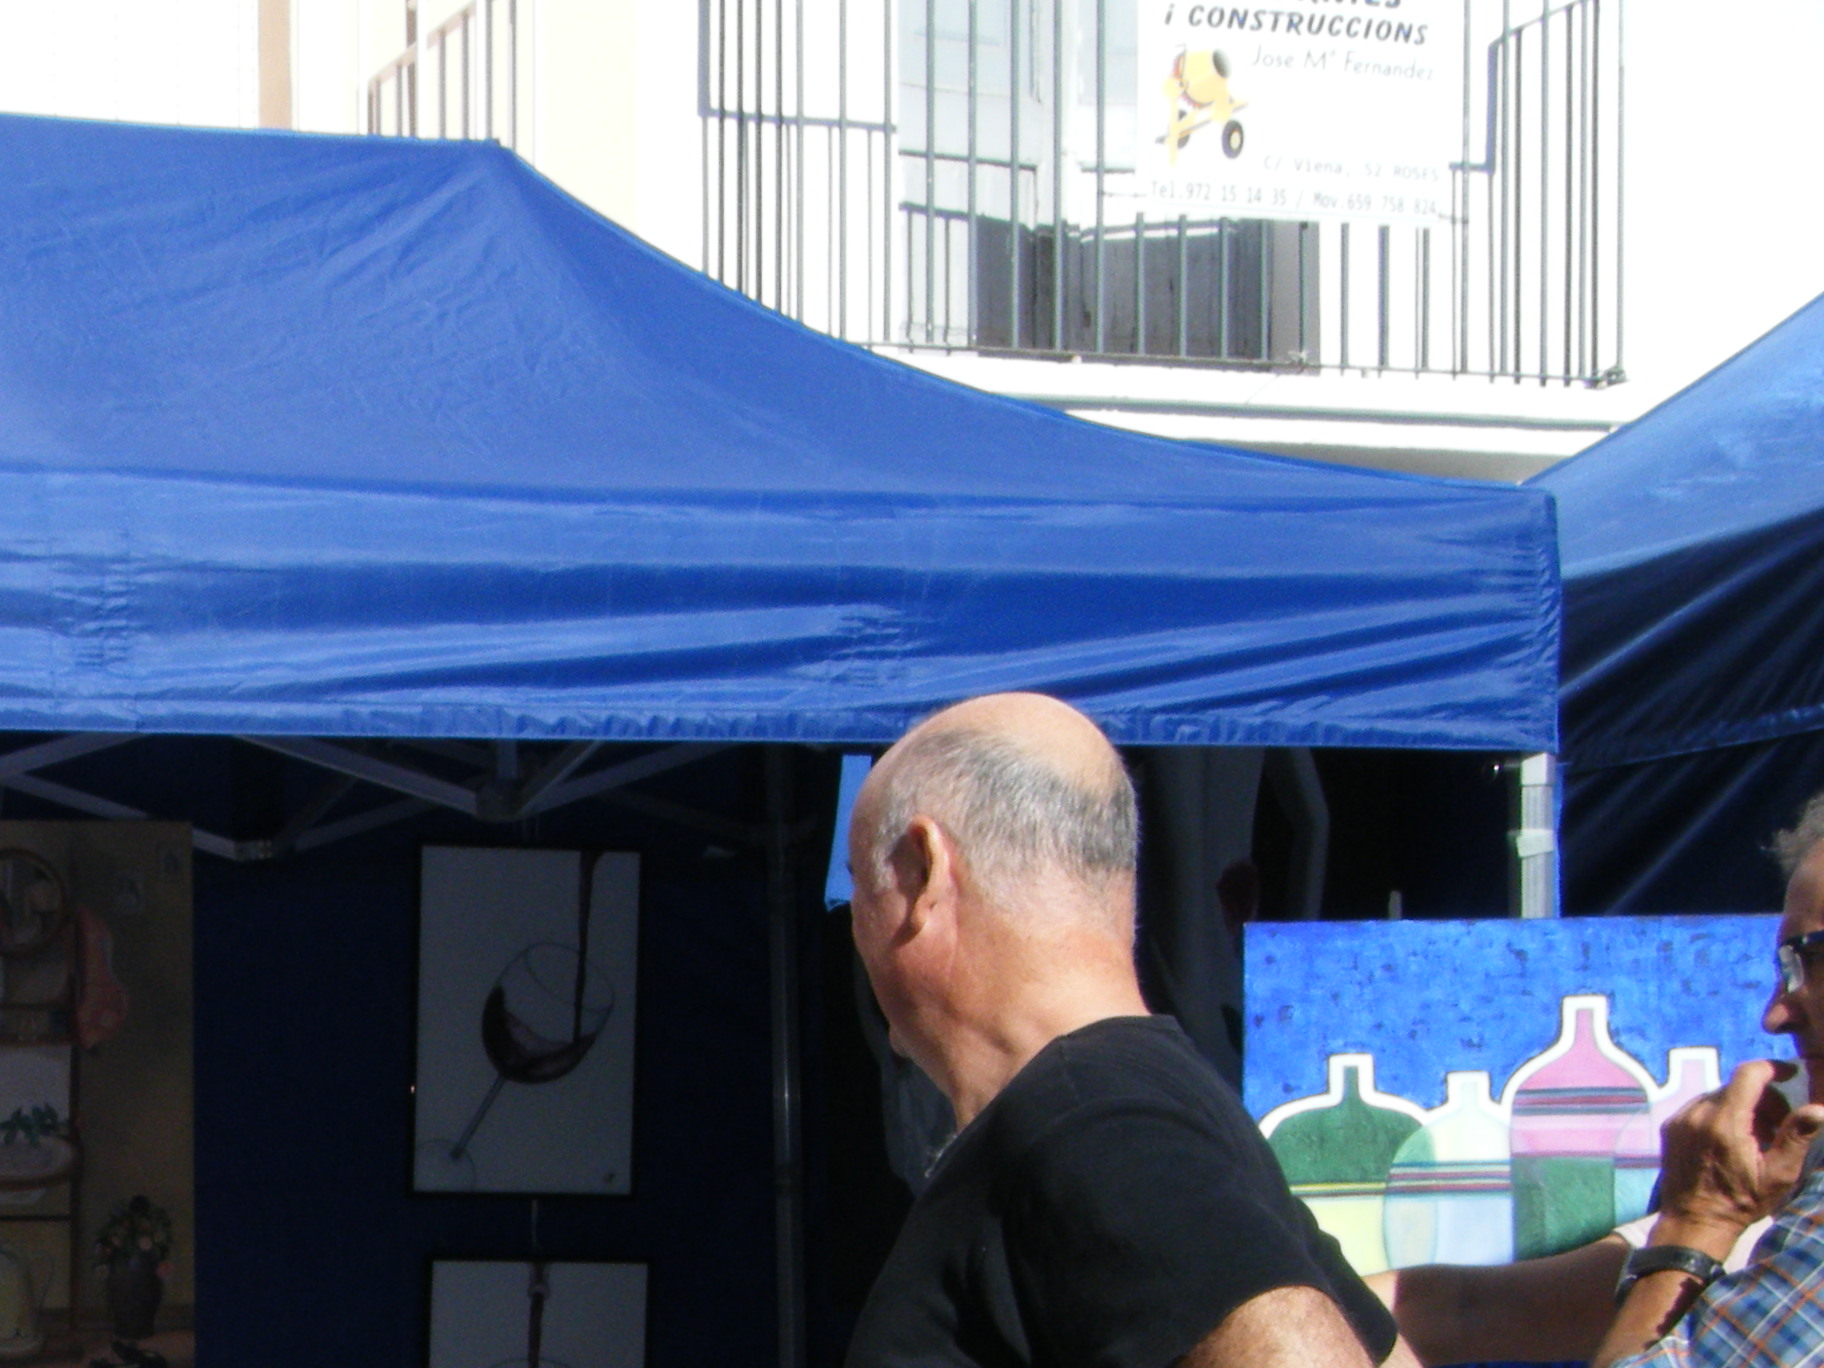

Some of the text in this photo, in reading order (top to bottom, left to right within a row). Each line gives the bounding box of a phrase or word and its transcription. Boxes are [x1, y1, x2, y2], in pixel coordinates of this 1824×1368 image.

[1188, 5, 1429, 45] CONSTRUCCIONS
[1294, 158, 1350, 178] Viena,
[1393, 164, 1439, 182] ROSES
[1221, 184, 1237, 203] 15
[1246, 186, 1263, 204] 14
[1271, 188, 1287, 206] 35
